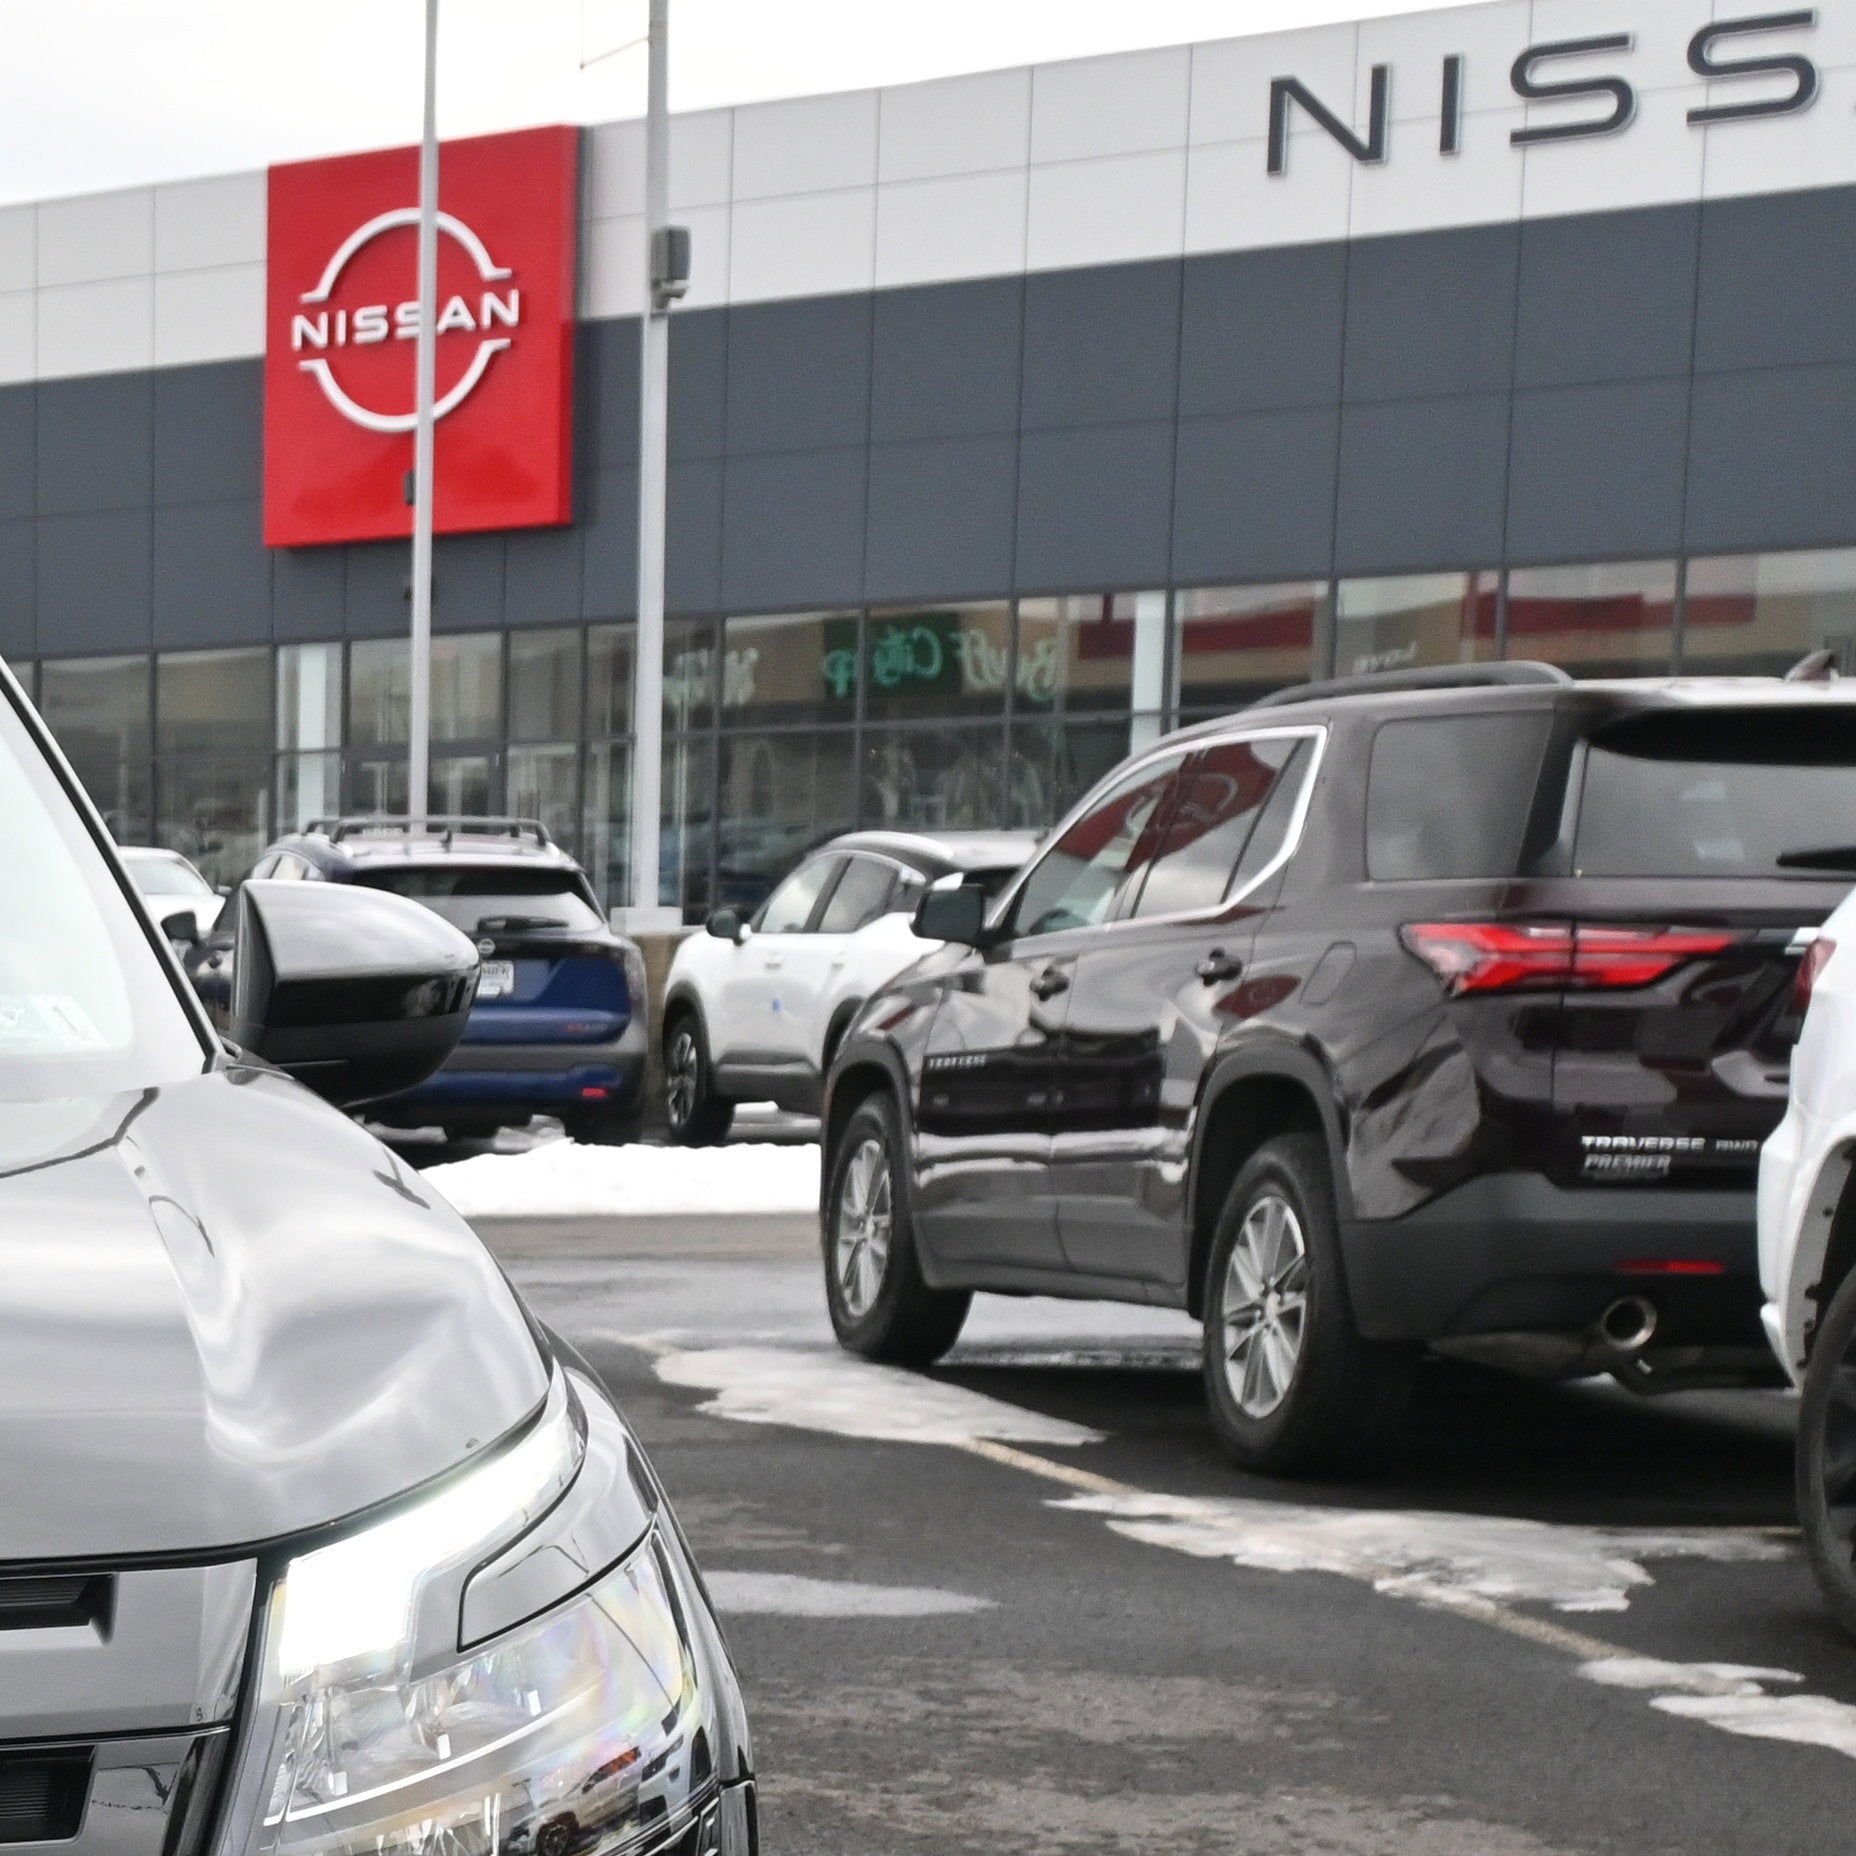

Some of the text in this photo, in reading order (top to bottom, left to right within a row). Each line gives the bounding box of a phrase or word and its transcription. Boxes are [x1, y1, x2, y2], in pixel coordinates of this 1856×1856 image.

[1266, 7, 1856, 177] NISS
[292, 288, 520, 350] NISSAN
[1582, 1135, 1706, 1150] TRAVERSE
[1584, 1153, 1672, 1170] PREMIER
